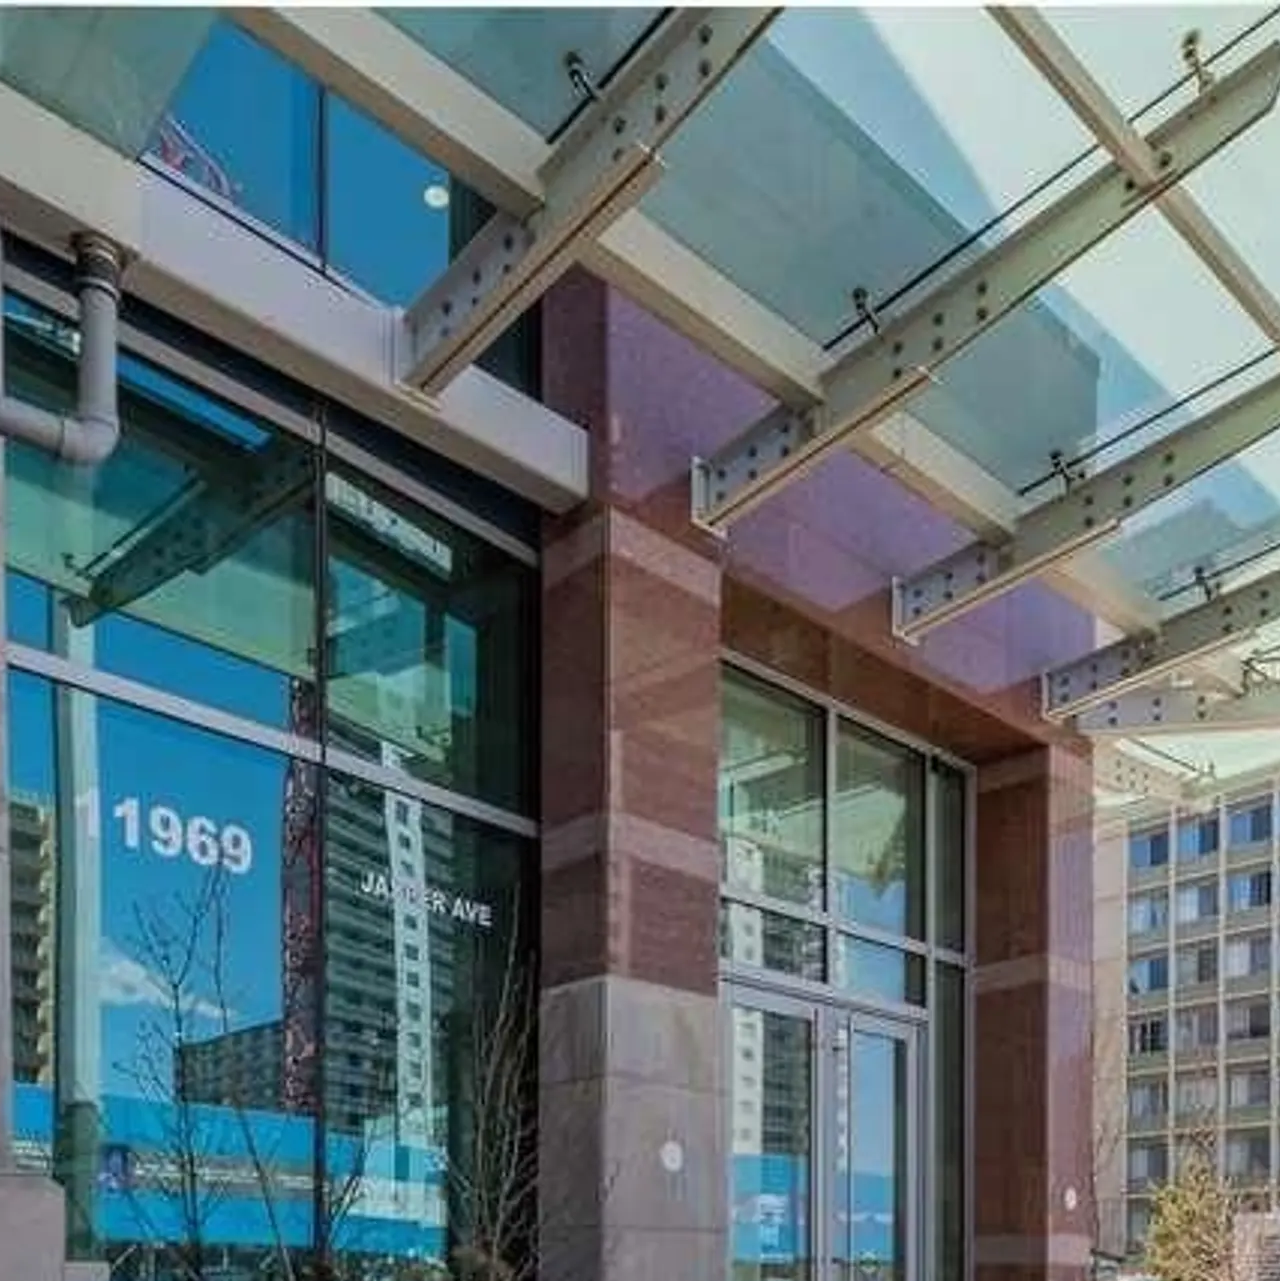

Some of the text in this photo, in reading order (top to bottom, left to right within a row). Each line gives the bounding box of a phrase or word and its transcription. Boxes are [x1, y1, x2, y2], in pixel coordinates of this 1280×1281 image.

[75, 786, 253, 876] 11969
[361, 869, 493, 927] JAPER AVE
